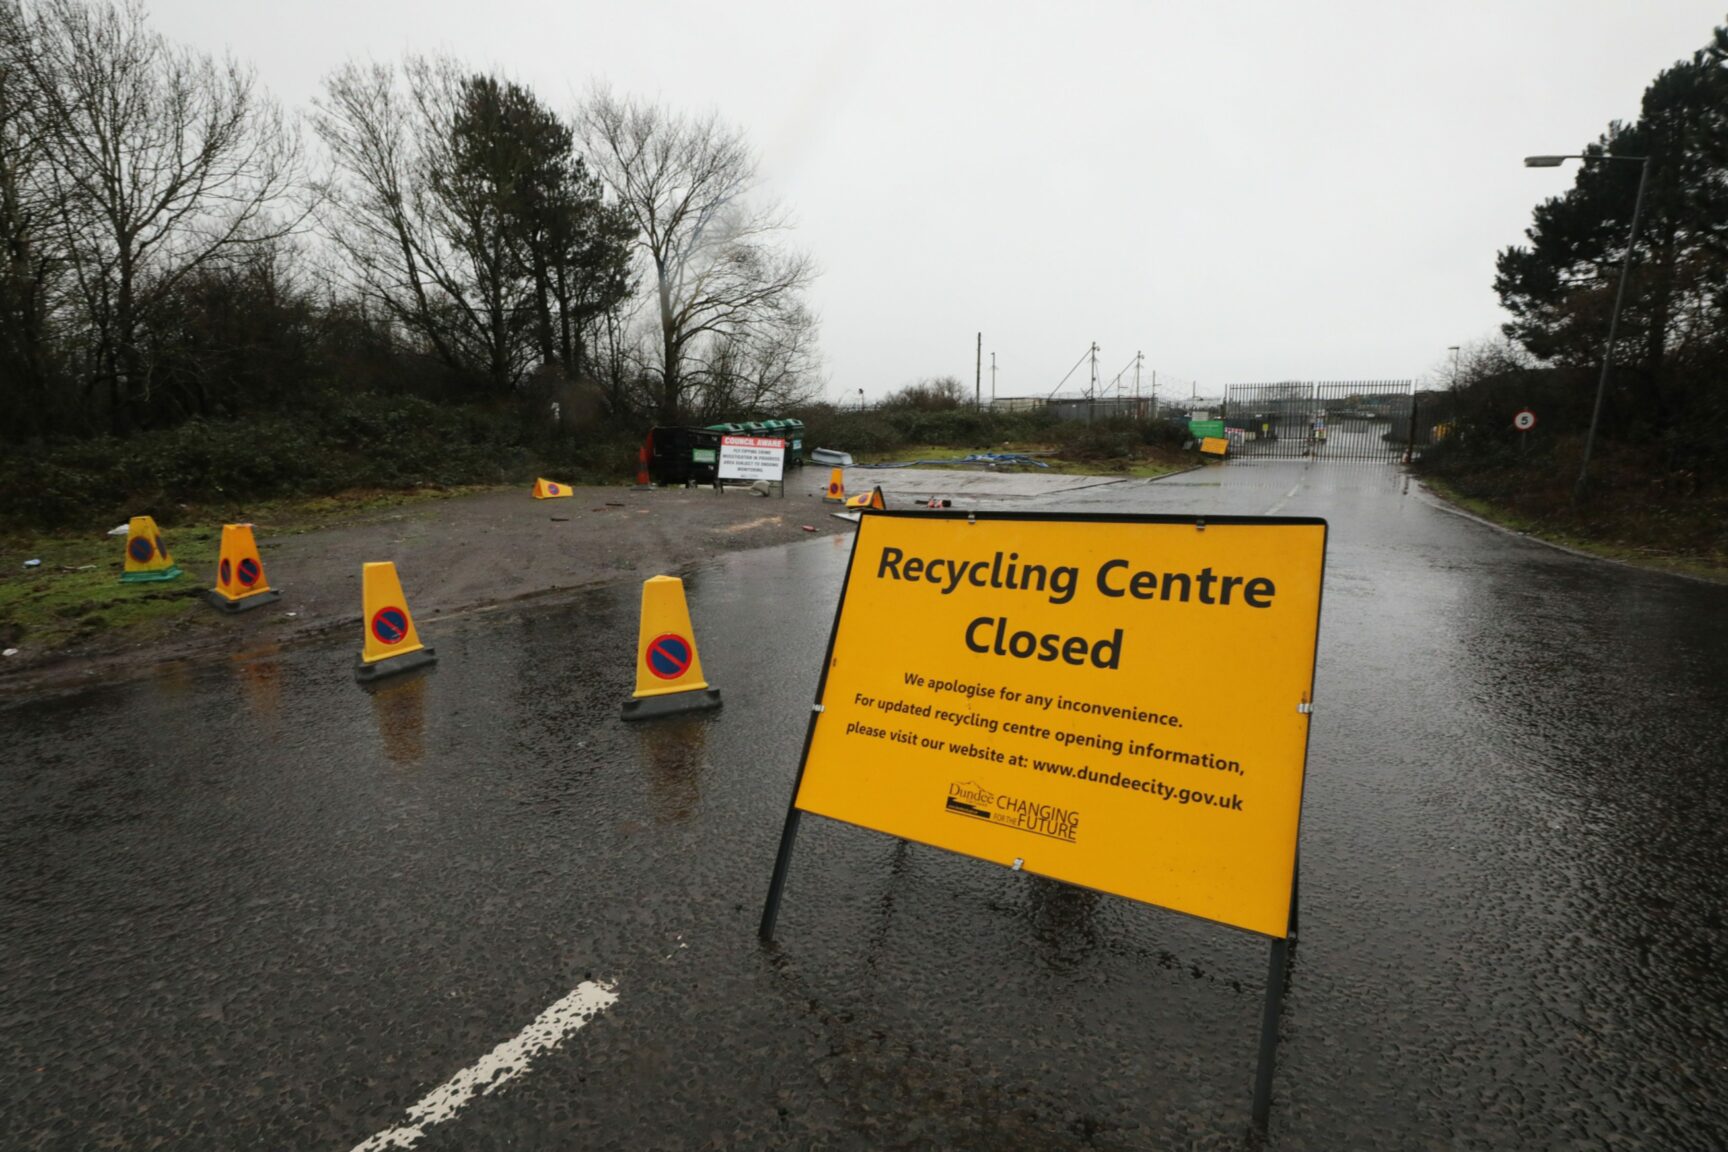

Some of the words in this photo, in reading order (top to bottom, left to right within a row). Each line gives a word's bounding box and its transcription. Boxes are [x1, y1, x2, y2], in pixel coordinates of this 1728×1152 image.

[724, 436, 752, 445] COUNCIL
[757, 439, 782, 447] AWARE
[1521, 416, 1529, 425] 5
[877, 546, 1079, 605] Recycling
[1096, 559, 1276, 609] Centre
[965, 616, 1124, 670] Closed
[904, 672, 925, 687] We
[927, 679, 996, 699] apologise
[999, 686, 1022, 702] for
[1025, 694, 1053, 710] any
[1057, 696, 1183, 728] inconvenience.
[854, 693, 875, 707] For
[877, 700, 932, 718] updated
[934, 709, 999, 733] recycling
[1002, 722, 1051, 740] centre
[1055, 731, 1123, 756] opening
[1128, 740, 1244, 776] information,
[846, 721, 887, 739] please
[890, 730, 918, 746] visit
[921, 738, 945, 750] our
[949, 743, 1005, 764] website
[1008, 754, 1029, 768] at:
[1032, 759, 1243, 812] www.dundeecity.gov.uk
[949, 783, 994, 804] Dundee
[996, 795, 1079, 827] CHANGING
[993, 813, 1005, 823] FOR
[1005, 816, 1017, 826] THE
[1017, 813, 1077, 840] FUTURE
